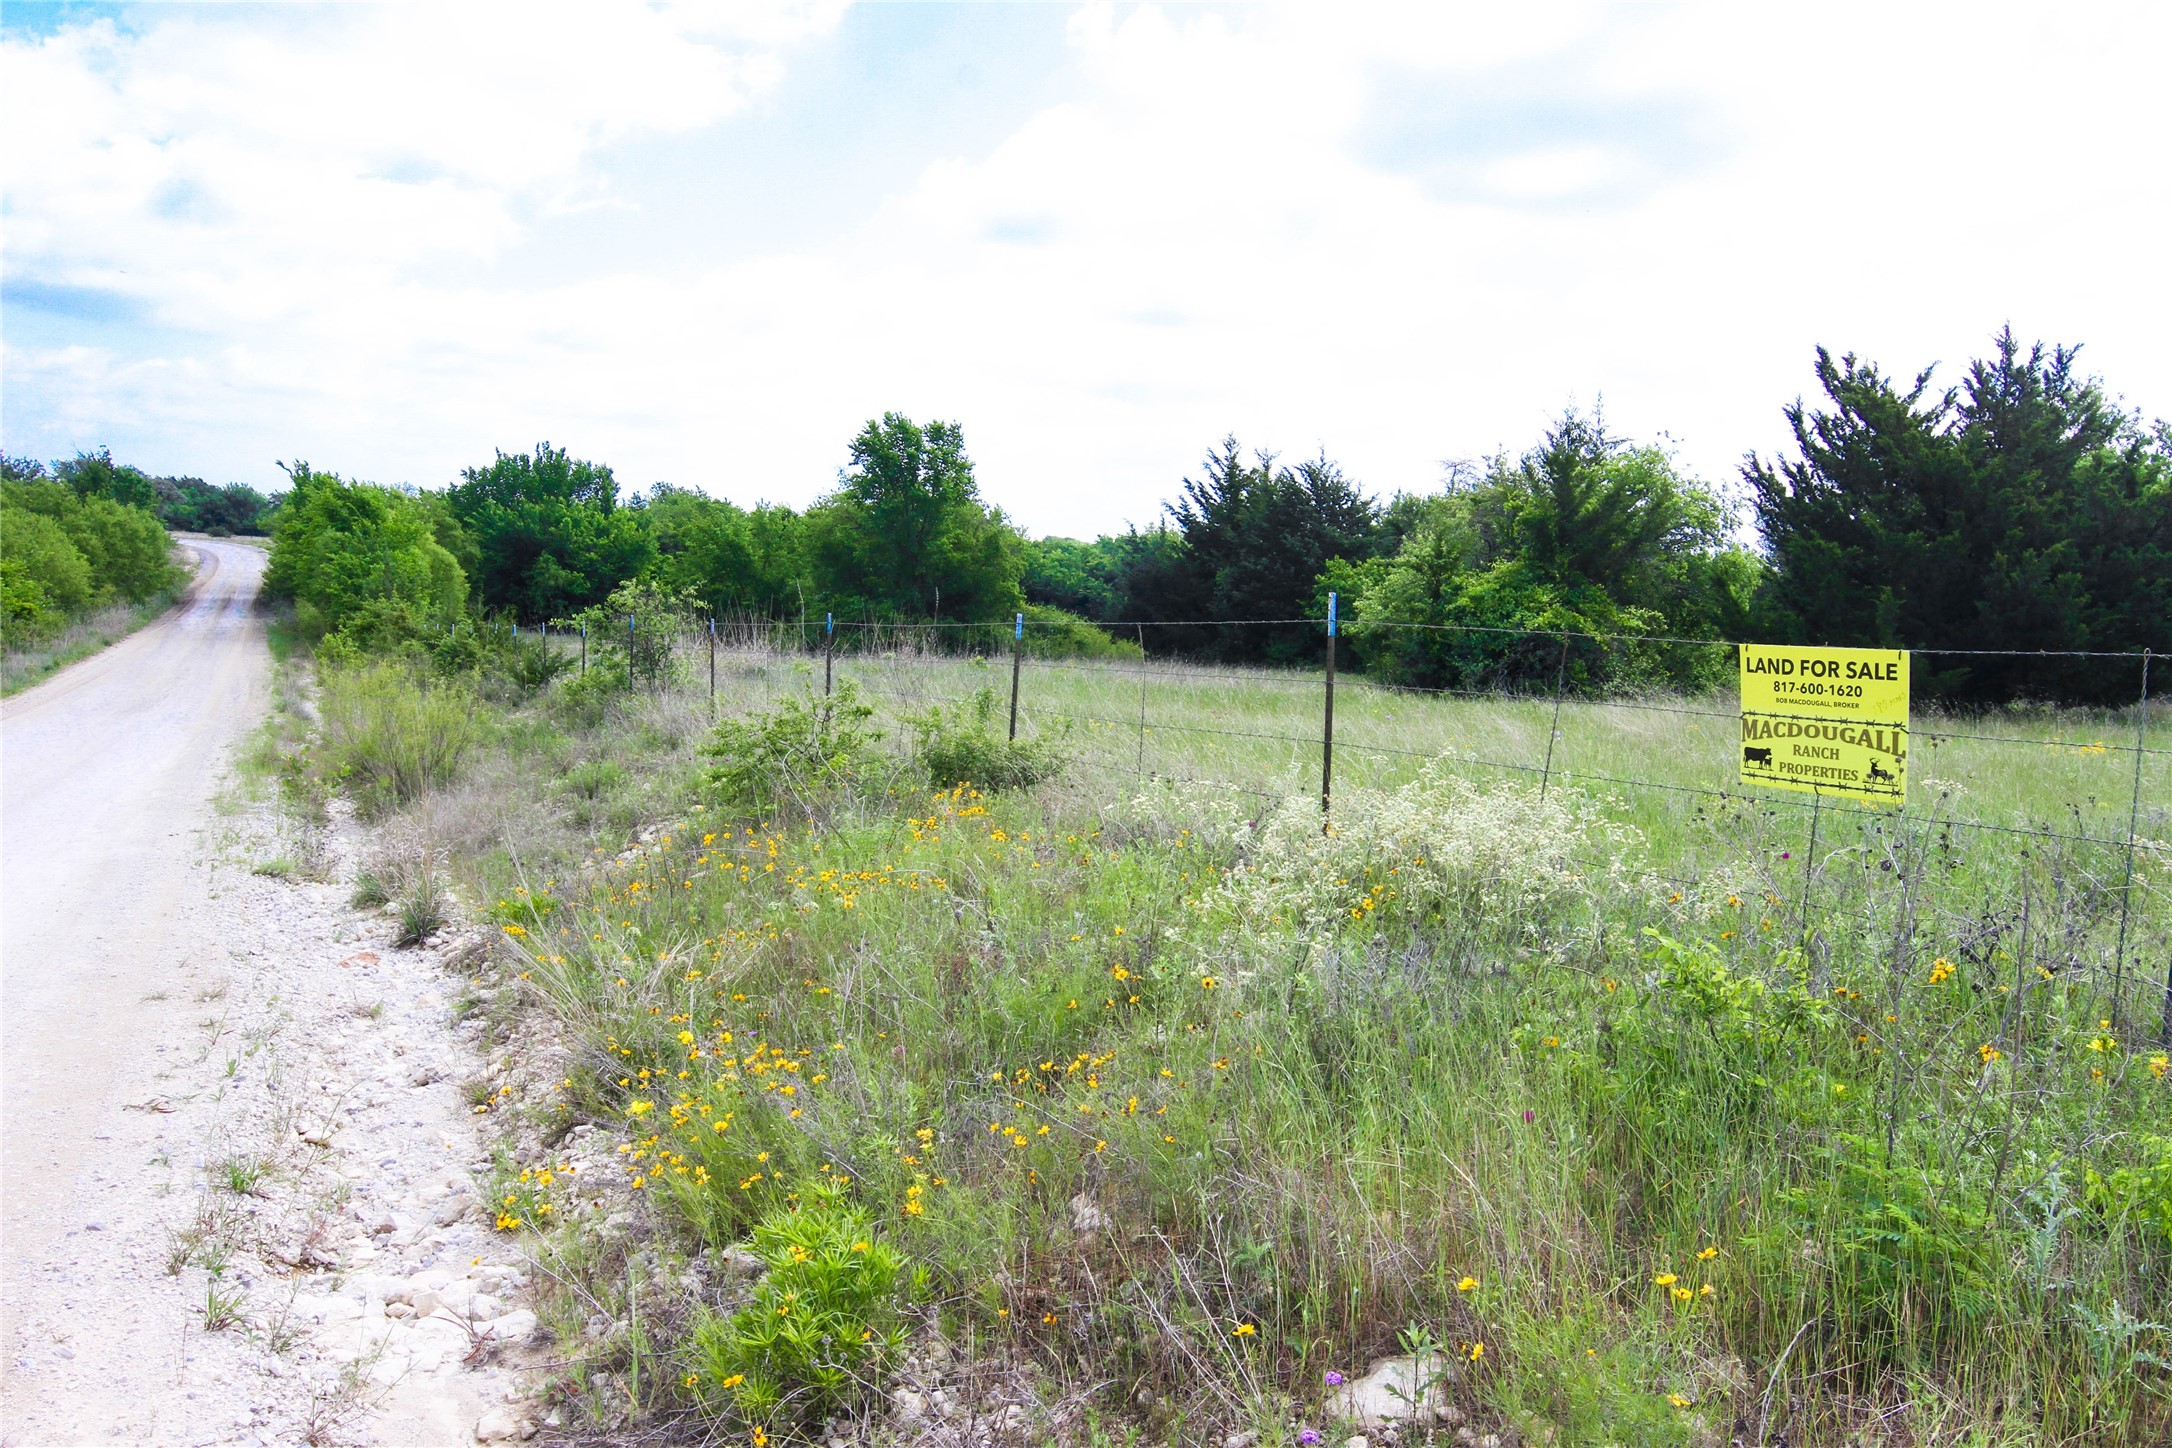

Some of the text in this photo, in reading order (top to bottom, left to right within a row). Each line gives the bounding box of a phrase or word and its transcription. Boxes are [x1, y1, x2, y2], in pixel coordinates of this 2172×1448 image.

[1746, 657, 1898, 681] LAND FOR SALE
[1773, 681, 1863, 697] 817-600-1620
[1742, 718, 1906, 759] MACDOUGALL
[1792, 744, 1840, 760] RANCH
[1779, 761, 1859, 782] PROPERTIES
